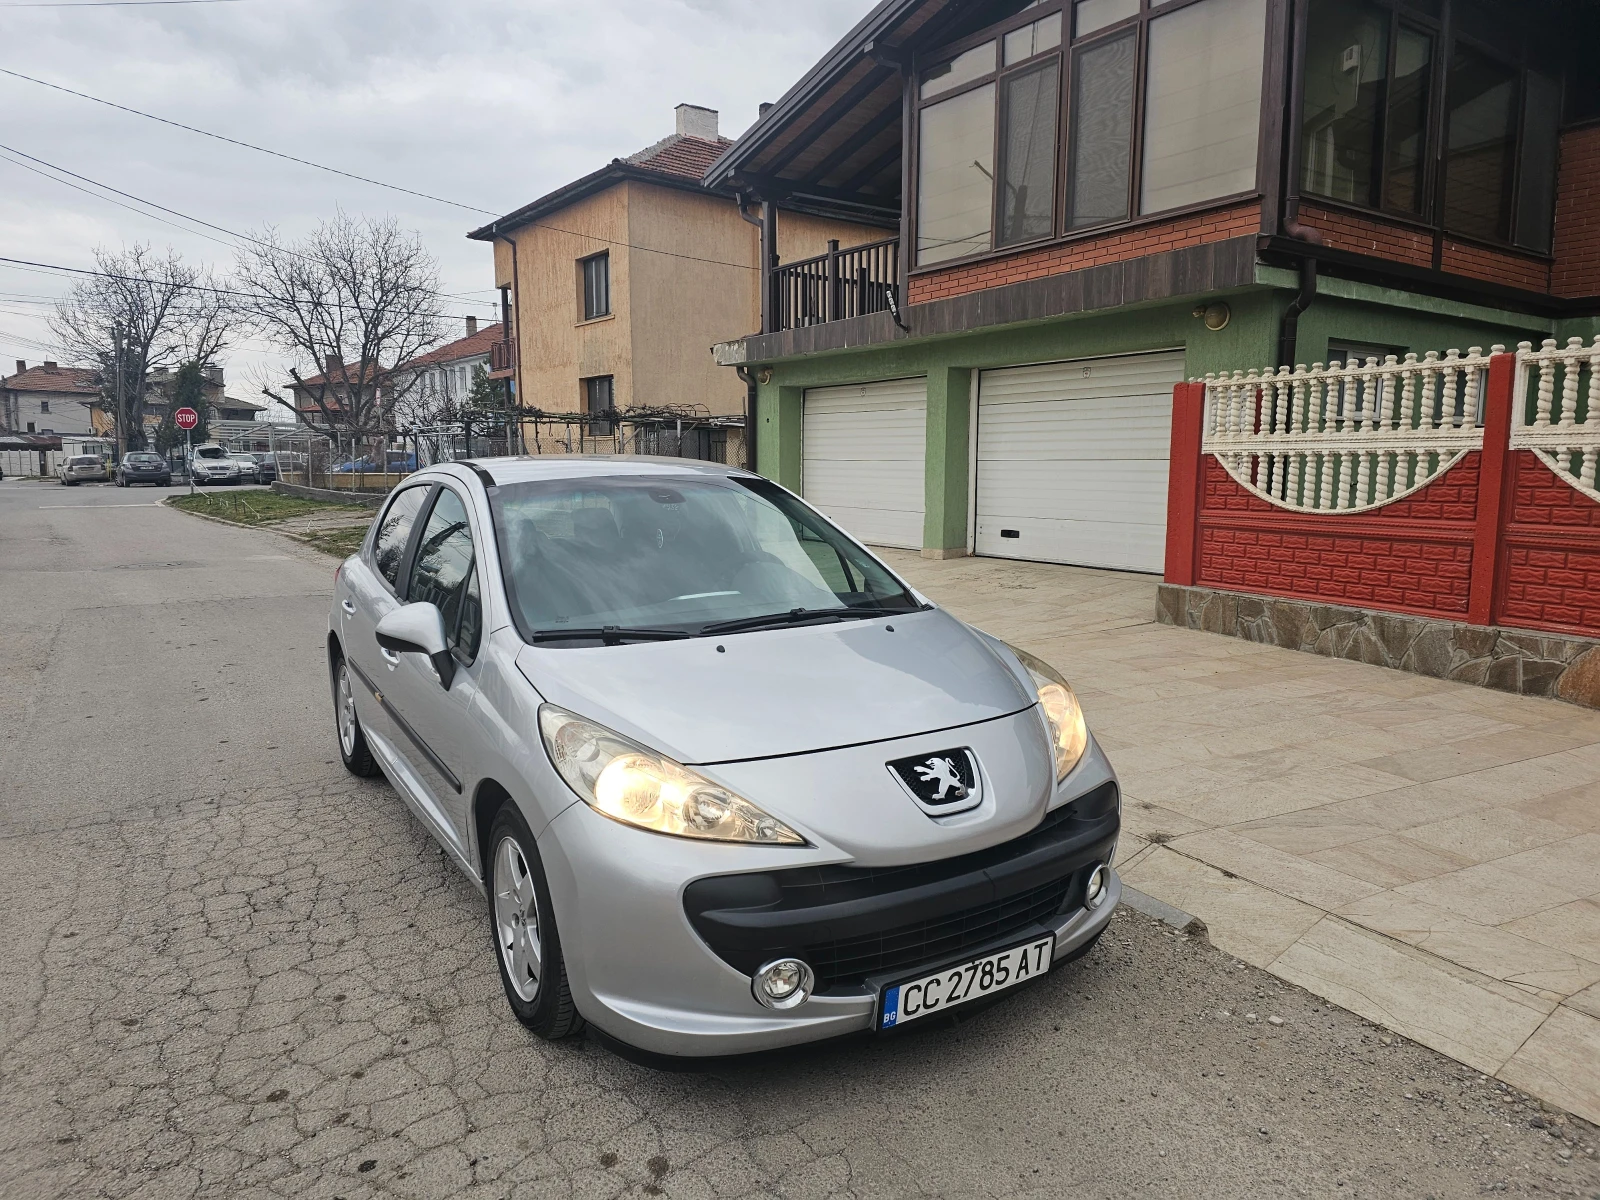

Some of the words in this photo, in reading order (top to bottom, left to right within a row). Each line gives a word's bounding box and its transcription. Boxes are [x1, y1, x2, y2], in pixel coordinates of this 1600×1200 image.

[177, 413, 195, 423] STOP
[903, 977, 941, 1016] CC
[945, 954, 1010, 1003] 2785
[1015, 941, 1049, 979] AT
[883, 1011, 896, 1024] BG
